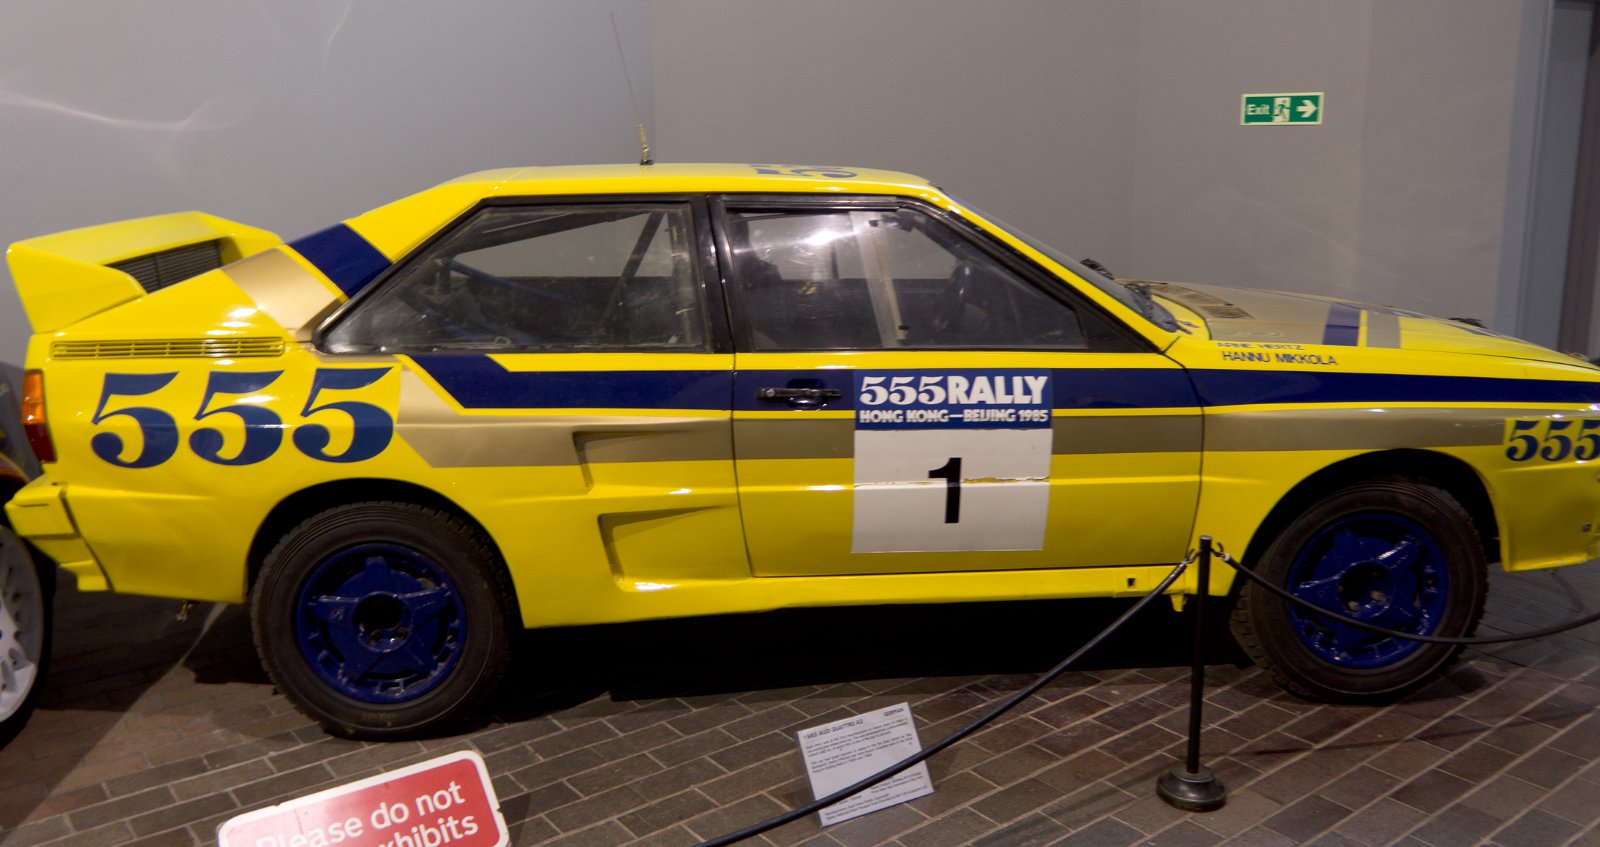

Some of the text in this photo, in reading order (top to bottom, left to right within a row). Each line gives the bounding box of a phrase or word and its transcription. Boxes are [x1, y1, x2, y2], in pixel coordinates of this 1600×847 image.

[1247, 104, 1270, 115] Exit
[1221, 351, 1338, 365] HANNU MIKKOLA
[91, 367, 394, 469] 555
[859, 410, 903, 423] HONG
[1019, 409, 1049, 422] 1985
[1505, 420, 1600, 462] 555
[928, 457, 962, 524] 1
[370, 801, 409, 830] do
[415, 781, 466, 816] not
